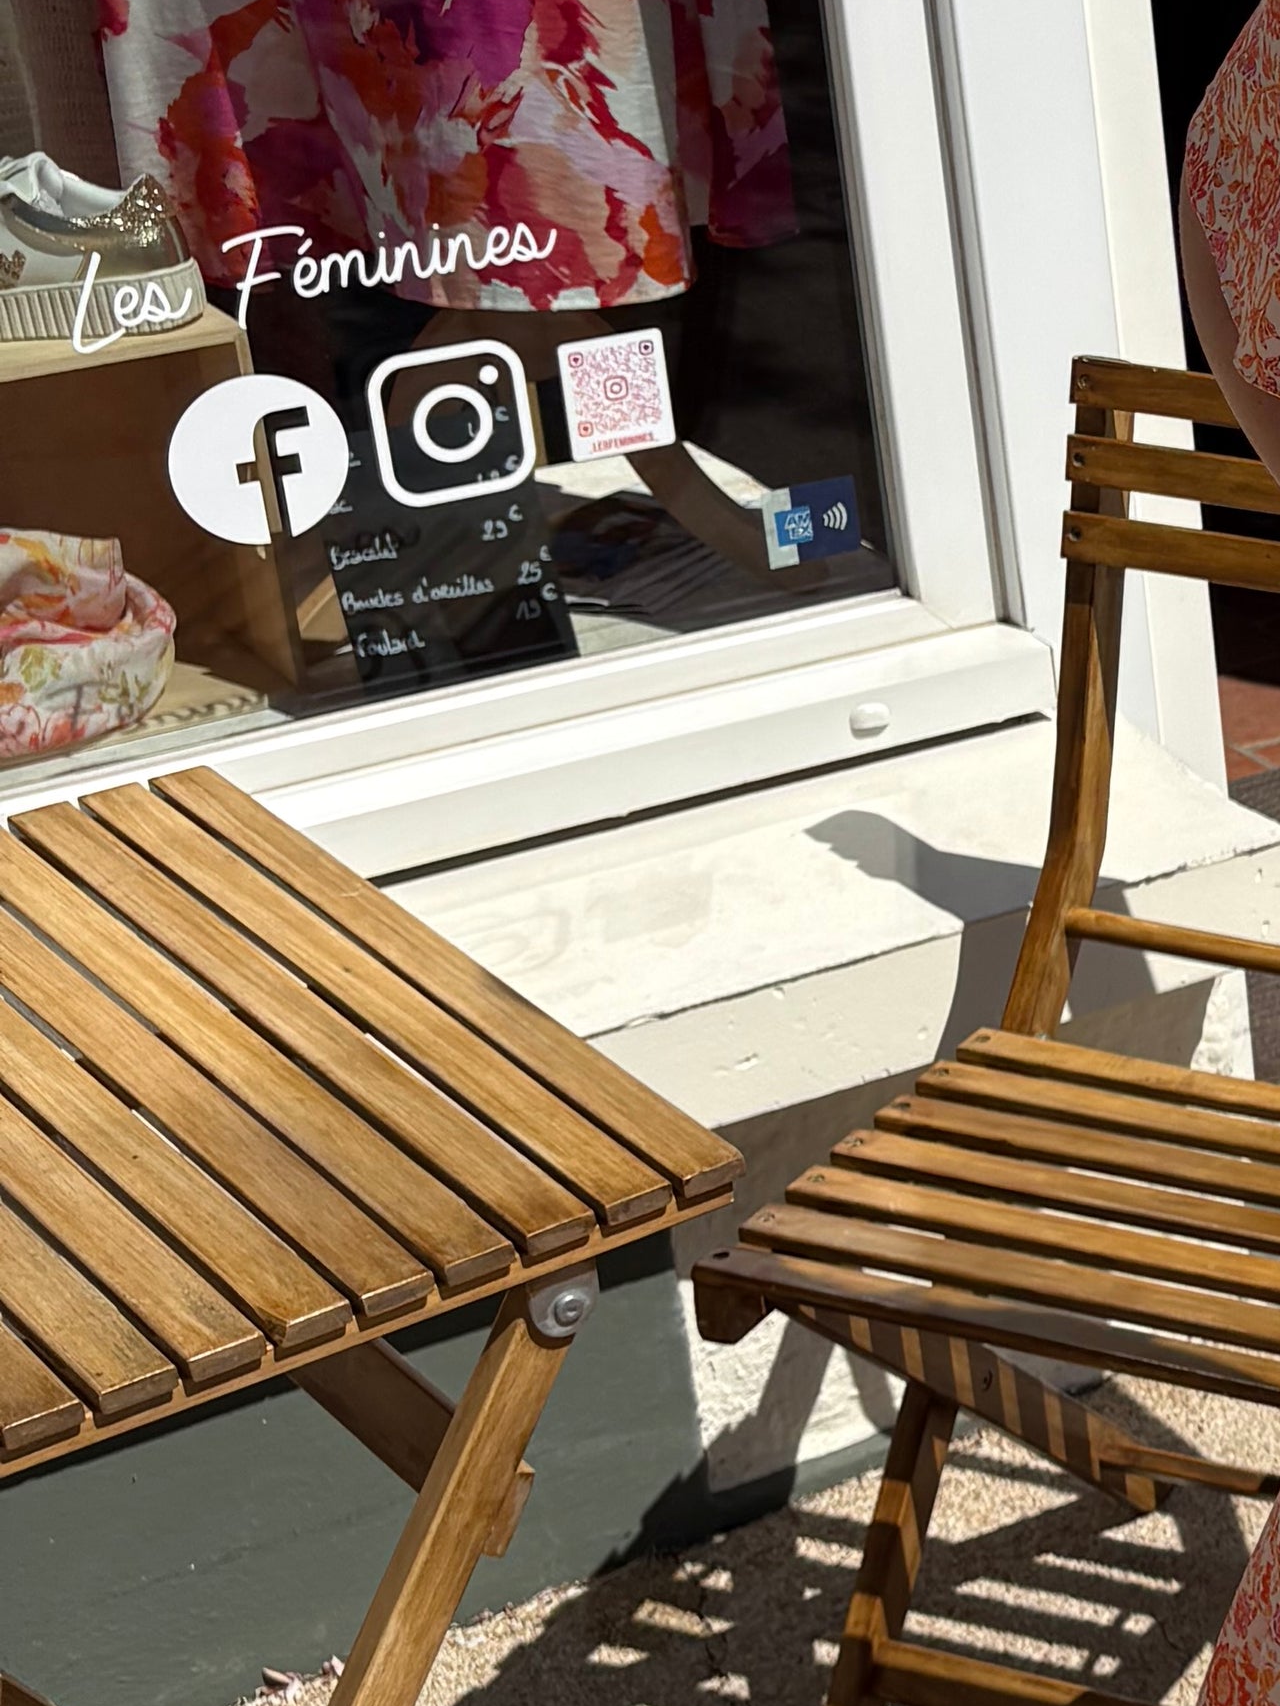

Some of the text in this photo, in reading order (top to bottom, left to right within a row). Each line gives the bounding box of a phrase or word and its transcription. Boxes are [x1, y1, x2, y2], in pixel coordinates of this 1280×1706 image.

[71, 222, 558, 355] Les Féminines
[356, 629, 427, 659] Foulard
